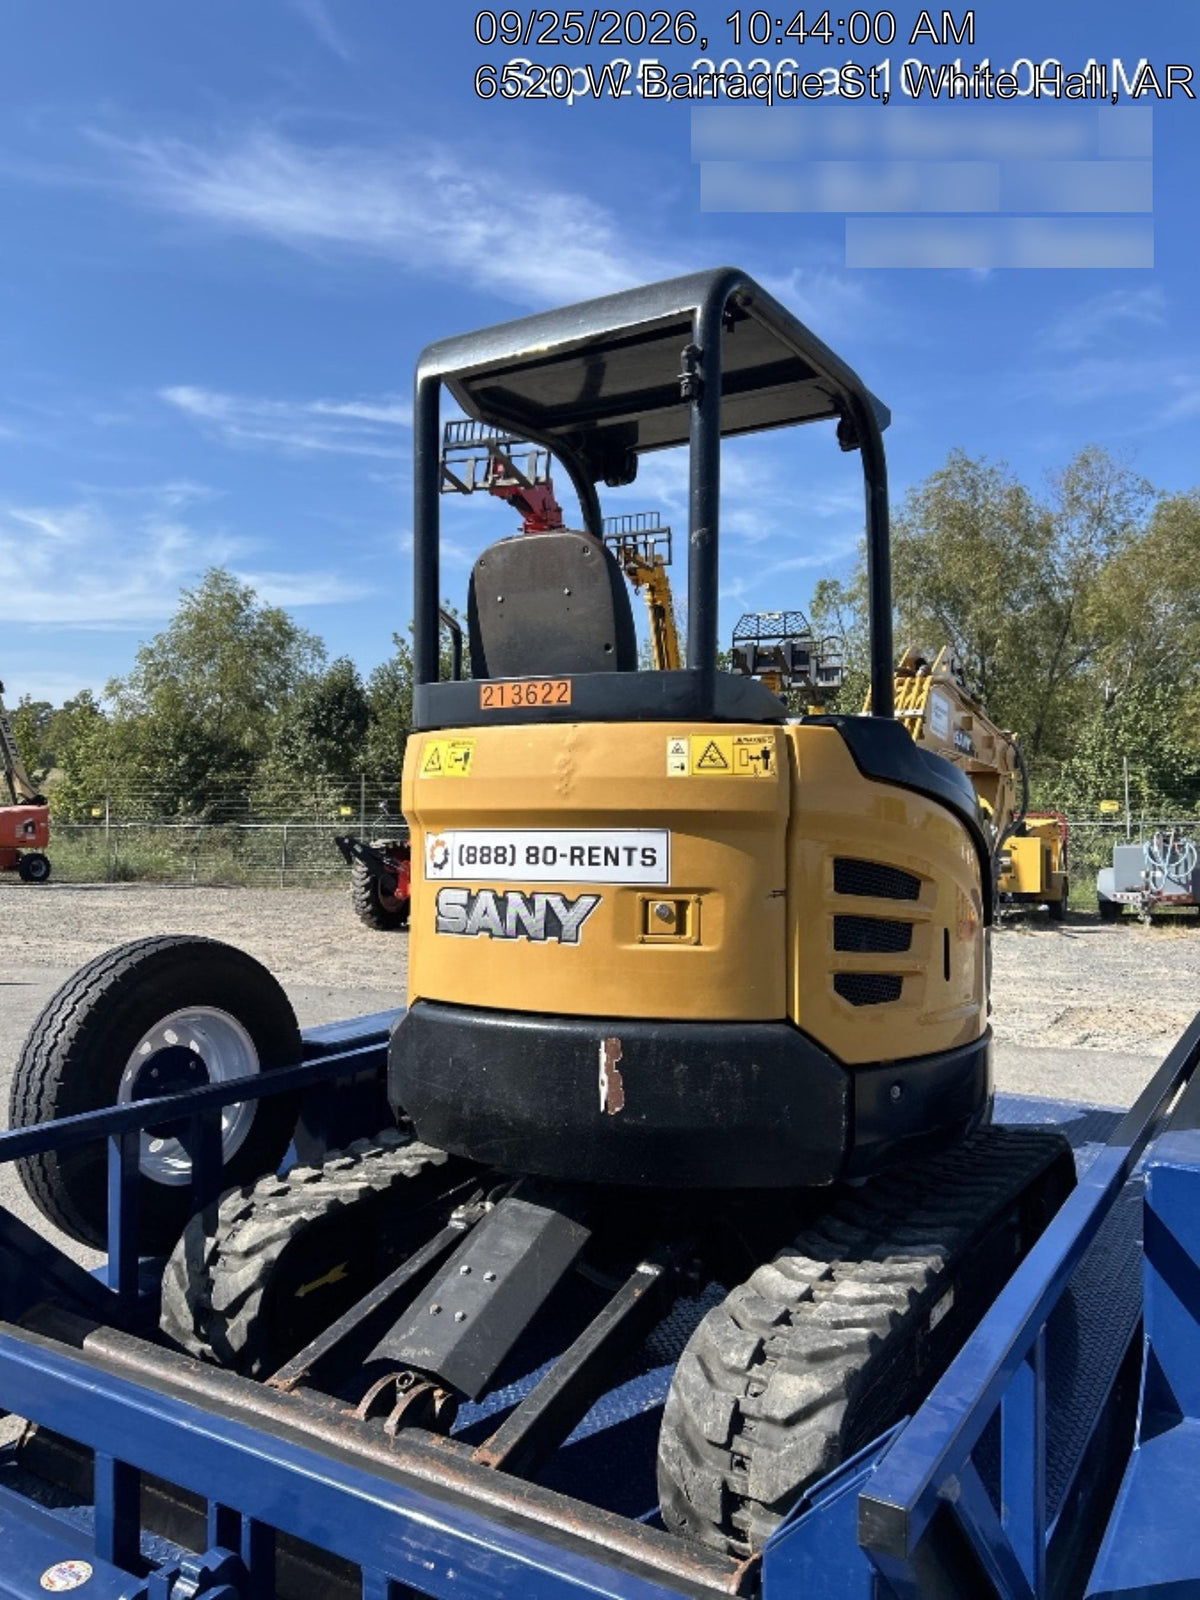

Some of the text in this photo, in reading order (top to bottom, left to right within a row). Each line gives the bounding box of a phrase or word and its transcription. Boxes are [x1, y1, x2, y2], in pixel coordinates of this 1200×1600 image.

[483, 682, 568, 706] 213622
[458, 844, 657, 867] (888) 80-RENTS
[435, 887, 602, 945] SANY
